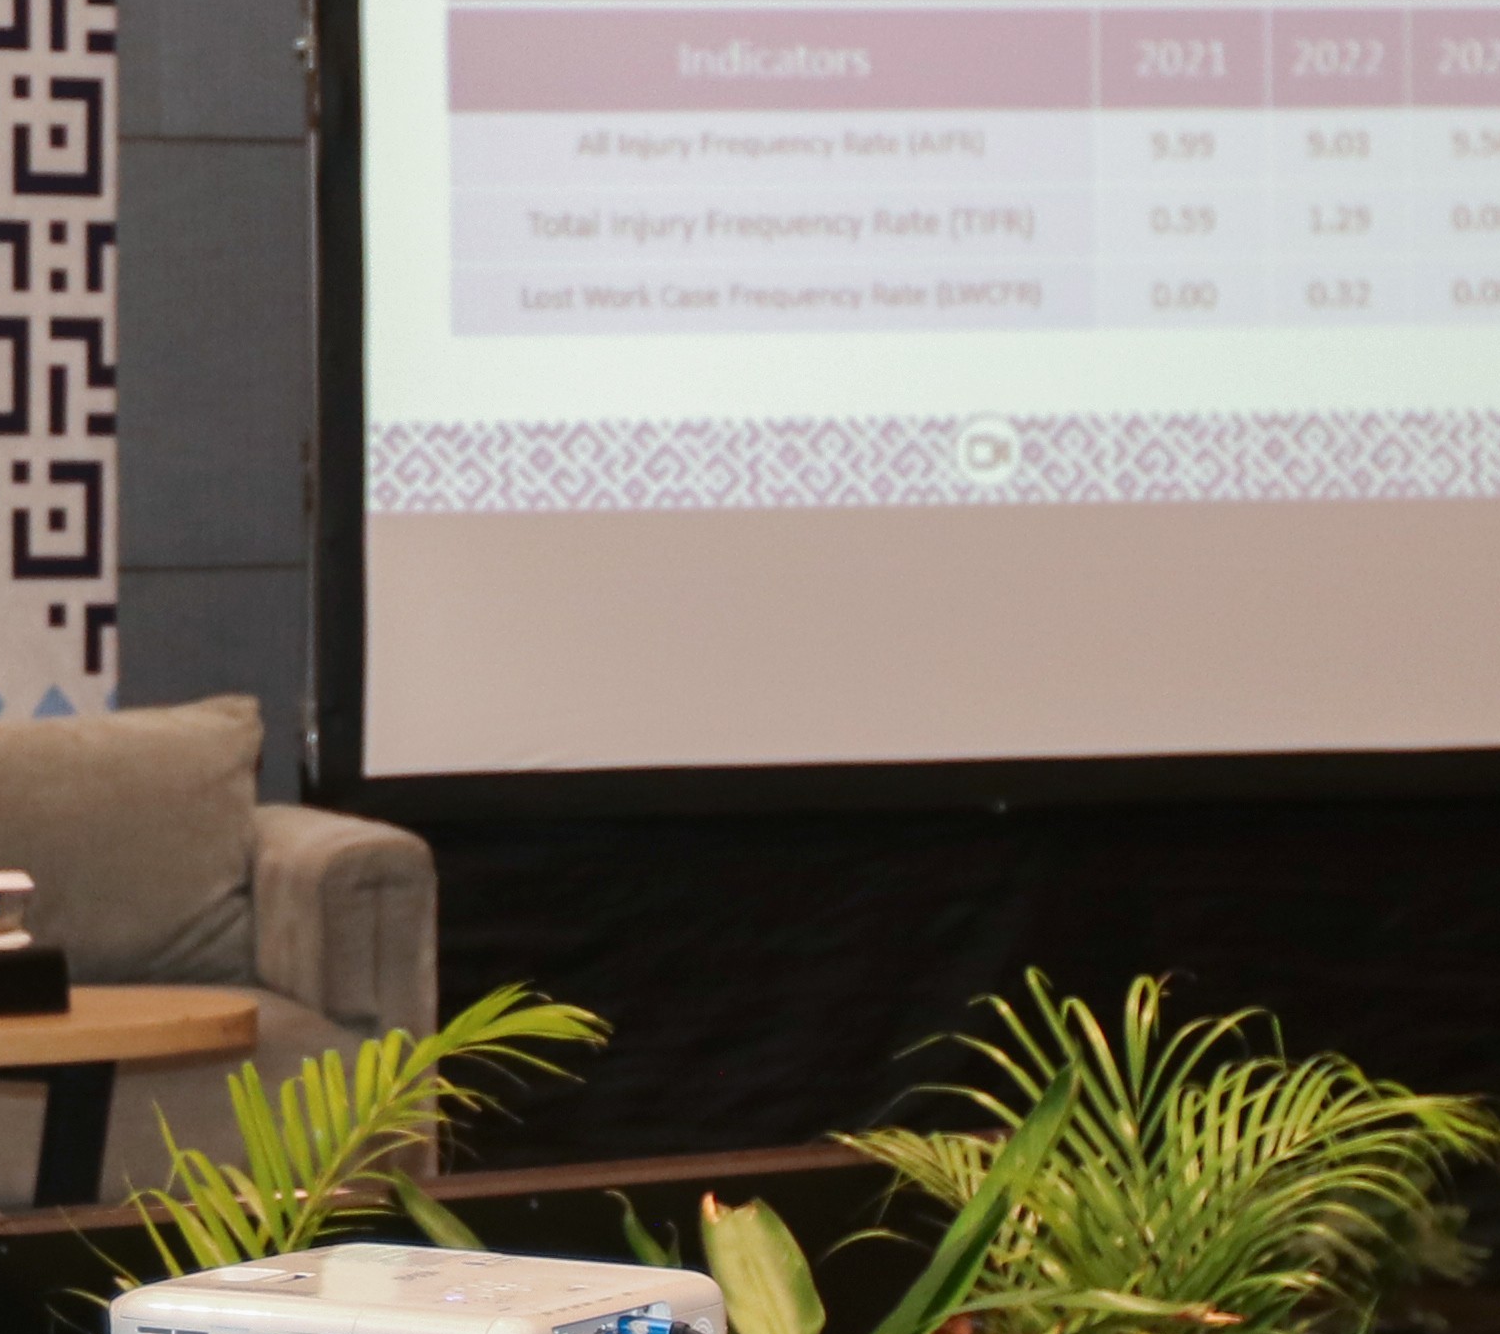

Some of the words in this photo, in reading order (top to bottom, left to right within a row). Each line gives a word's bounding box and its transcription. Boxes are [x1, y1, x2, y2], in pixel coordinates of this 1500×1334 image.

[678, 37, 870, 77] Indicators
[1135, 38, 1227, 77] 2021
[1291, 38, 1384, 77] 2022
[617, 129, 693, 160] Injury
[699, 129, 834, 160] Frequency
[843, 129, 899, 155] Rate
[526, 208, 598, 238] Total
[706, 208, 864, 242] Frequency
[873, 208, 939, 238] Rate
[520, 284, 575, 311] Lost
[582, 284, 652, 310] Work
[660, 284, 720, 310] Case
[728, 283, 862, 312] Frequency
[871, 281, 926, 308] Rate
